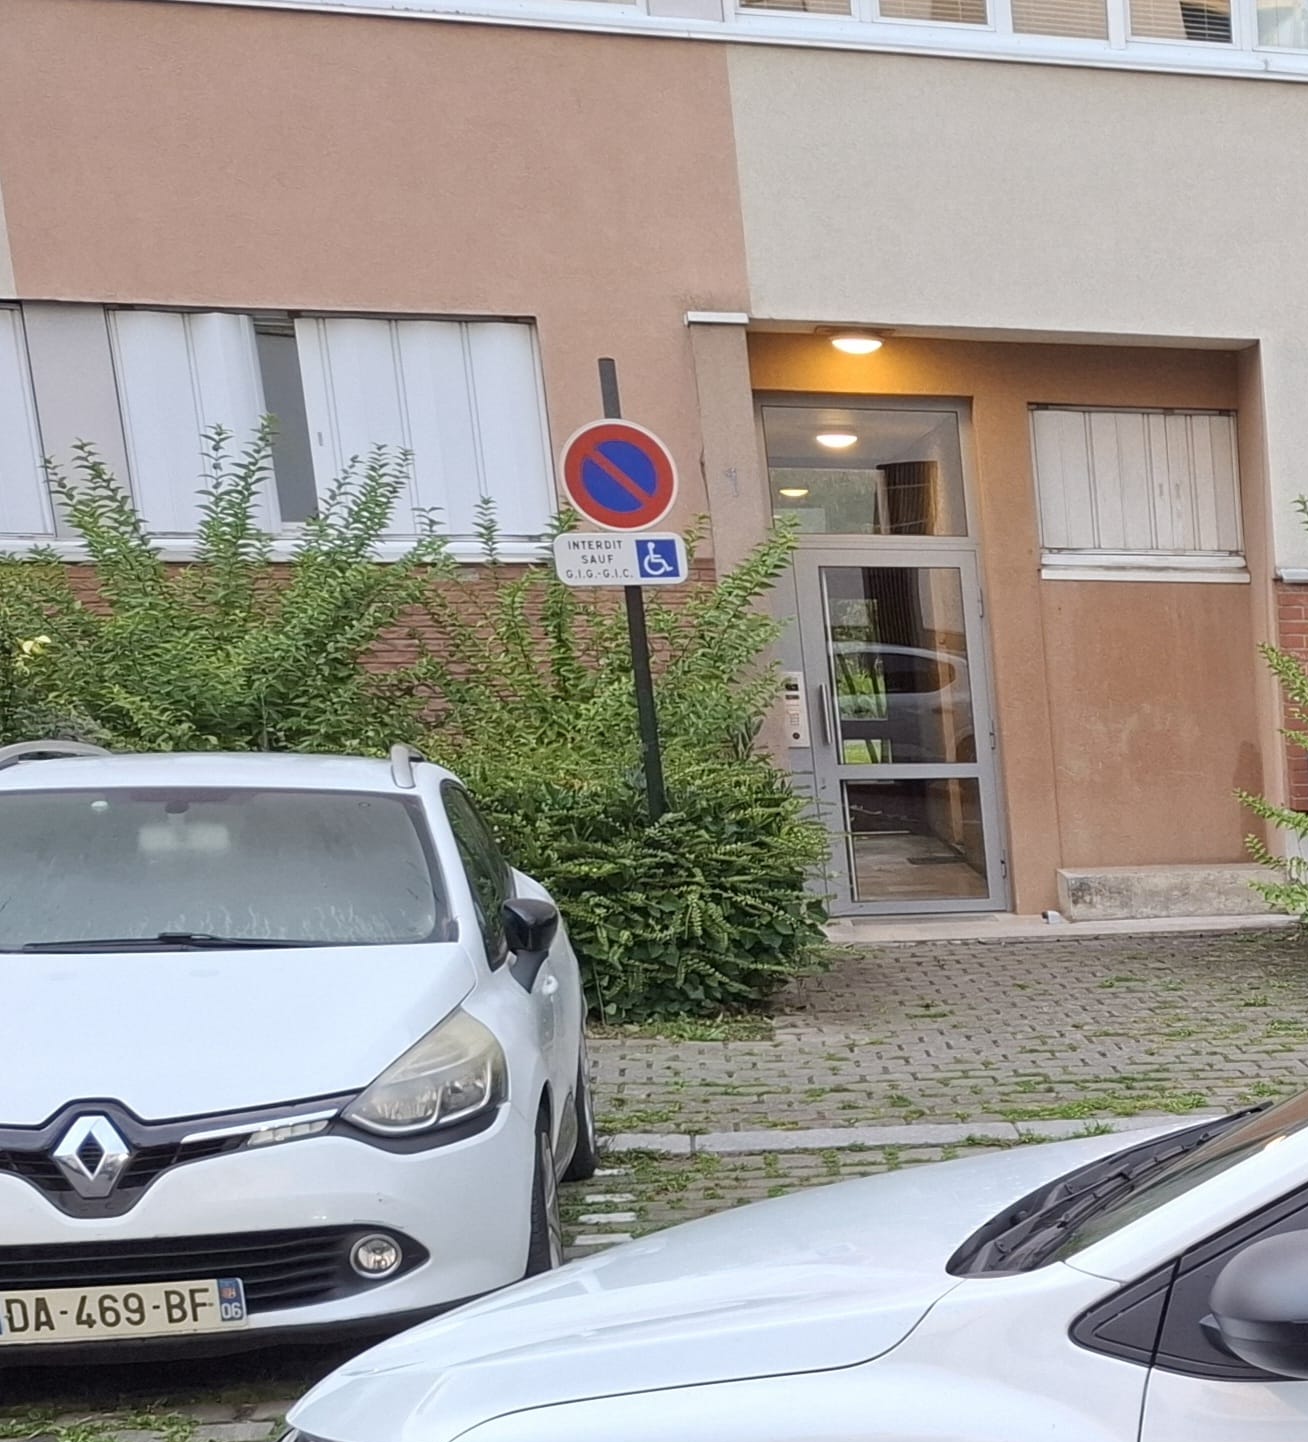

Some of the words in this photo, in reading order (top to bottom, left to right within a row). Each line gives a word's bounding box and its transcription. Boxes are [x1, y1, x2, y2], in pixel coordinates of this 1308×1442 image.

[567, 540, 623, 550] INTERDIT
[581, 554, 614, 564] SAUF
[4, 1287, 210, 1333] DA-469-BF
[221, 1302, 242, 1319] 06
